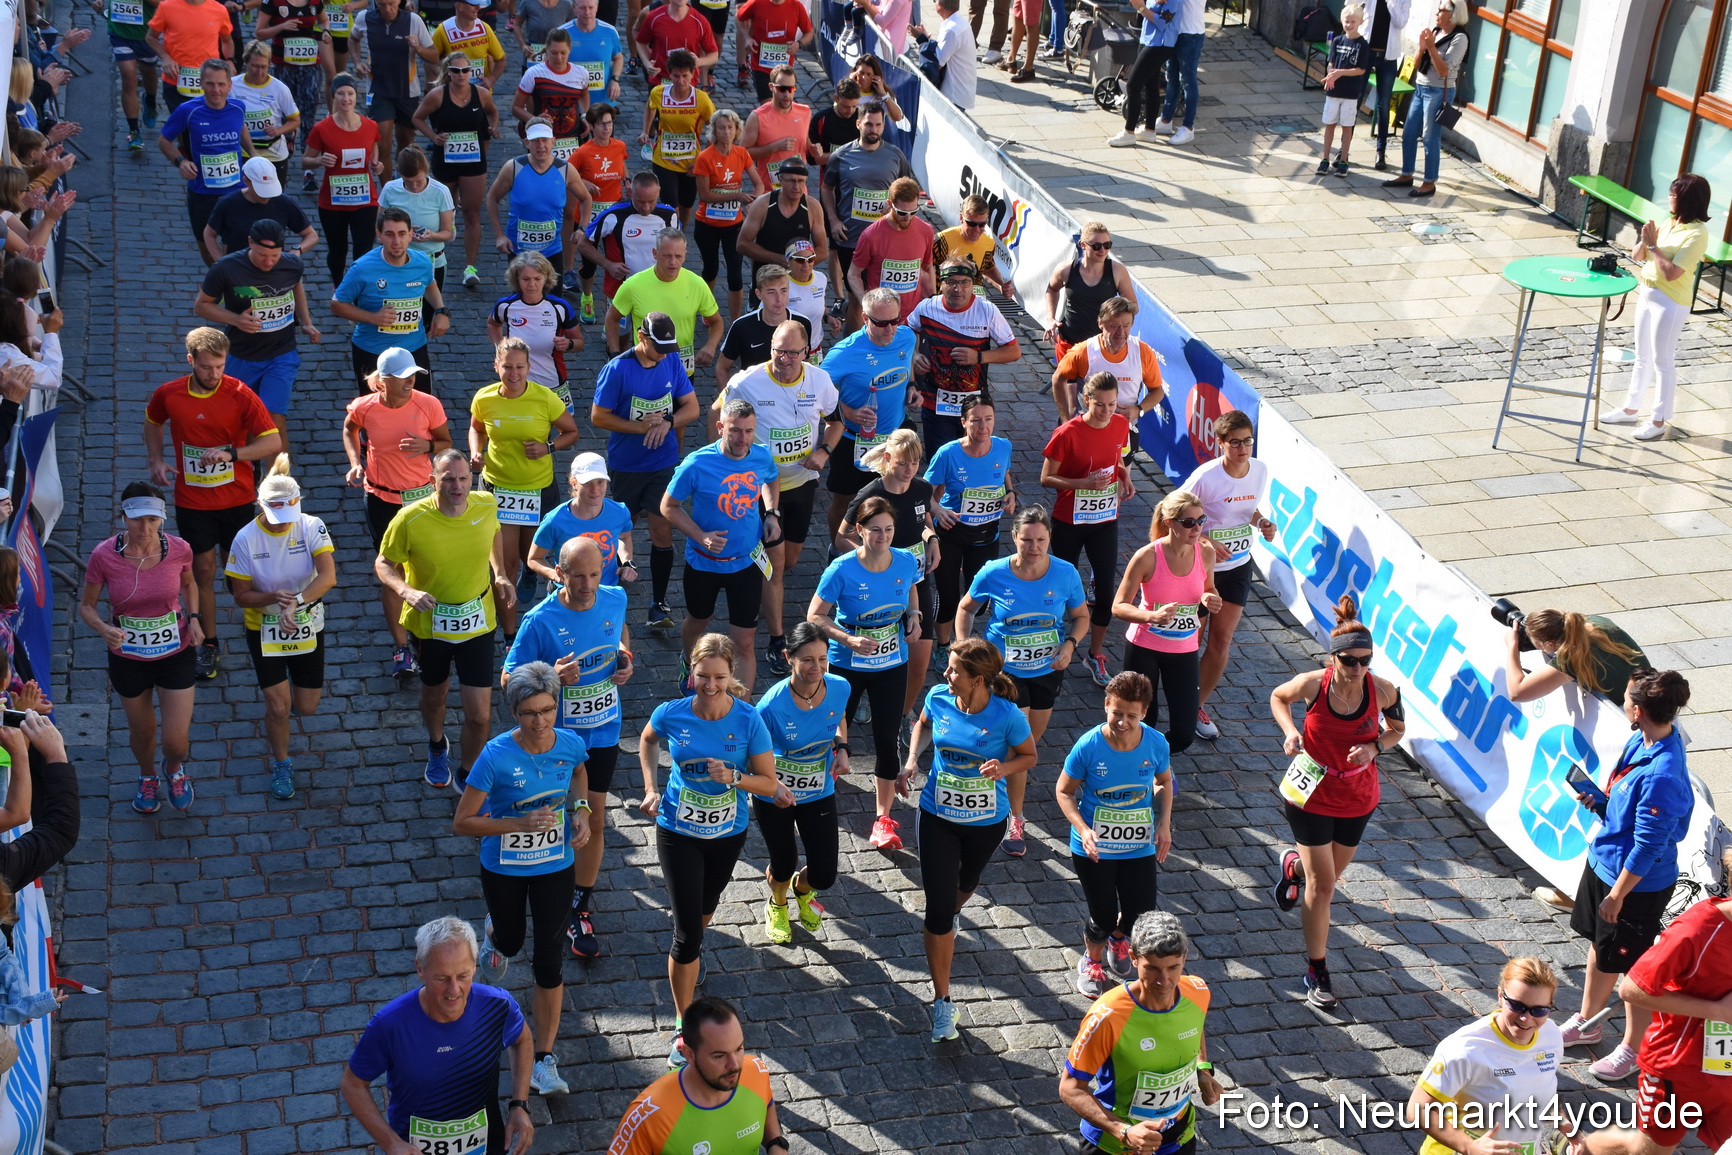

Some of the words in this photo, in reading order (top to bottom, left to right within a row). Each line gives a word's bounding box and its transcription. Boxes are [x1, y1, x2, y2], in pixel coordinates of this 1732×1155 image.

[114, 3, 139, 15] 2546
[328, 14, 345, 22] 182
[289, 48, 315, 56] 1220
[451, 43, 469, 51] MAX
[764, 52, 787, 61] 2565
[182, 77, 201, 88] 139
[202, 131, 239, 143] SYSCAD
[448, 142, 477, 154] 2726
[666, 141, 692, 151] 1237
[205, 154, 235, 165] BOCK
[207, 163, 237, 178] 2146
[333, 176, 365, 186] BOCK
[335, 186, 365, 196] 2581
[857, 190, 886, 199] BOCK
[960, 165, 1006, 238] swn
[714, 209, 734, 217] HELGA
[521, 221, 552, 230] BOCK
[522, 231, 552, 243] 2636
[886, 260, 918, 270] BOCK
[886, 271, 916, 283] 2035
[883, 282, 916, 290] ALEXANDER
[256, 296, 291, 309] BOCK
[259, 305, 291, 320] 2438
[396, 310, 419, 323] 189
[263, 318, 290, 329] ROBERT
[637, 398, 669, 409] BOCK
[773, 426, 809, 438] BOCK
[775, 436, 809, 454] 1055
[780, 453, 806, 463] STEFAN
[967, 489, 1005, 500] BOCK
[498, 496, 535, 511] 2214
[967, 501, 1003, 514] 2369
[1080, 497, 1114, 511] 2567
[500, 512, 530, 521] ANDREA
[968, 514, 996, 523] RENATE
[1078, 510, 1113, 520] CHRISTINE
[1213, 528, 1249, 539] BOCK
[1224, 538, 1250, 552] 720
[437, 602, 480, 616] BOCK
[125, 617, 171, 630] BOCK
[266, 612, 311, 625] BCK
[439, 613, 480, 632] 1397
[126, 629, 173, 646] 2129
[268, 625, 311, 641] 1029
[1010, 634, 1054, 647] BOCK
[282, 644, 299, 652] EVA
[871, 639, 897, 656] 366
[1012, 646, 1053, 662] 2362
[1015, 659, 1046, 668] MARGIT
[571, 681, 613, 697] BOCK
[571, 693, 613, 715] 2368
[576, 711, 610, 725] ROBERT
[777, 761, 823, 773] BOCK
[942, 775, 991, 791] BOCK
[1288, 763, 1311, 791] 375
[684, 791, 733, 808] BOCK
[942, 790, 989, 809] 2363
[683, 806, 731, 824] 2367
[944, 807, 987, 818] BRIGITTE
[1100, 811, 1150, 823] BOCK
[690, 824, 723, 835] NICOLE
[1100, 824, 1146, 840] 2009
[509, 828, 559, 849] 2370
[516, 850, 551, 860] INGRID
[1178, 1027, 1199, 1040] BOCK
[1145, 1060, 1199, 1089] BOCK
[1141, 1082, 1190, 1107] 2714
[414, 1111, 482, 1136] BOCK
[609, 1096, 661, 1155] BOCK
[737, 1122, 761, 1140] BOCK
[418, 1133, 479, 1155] 2814
